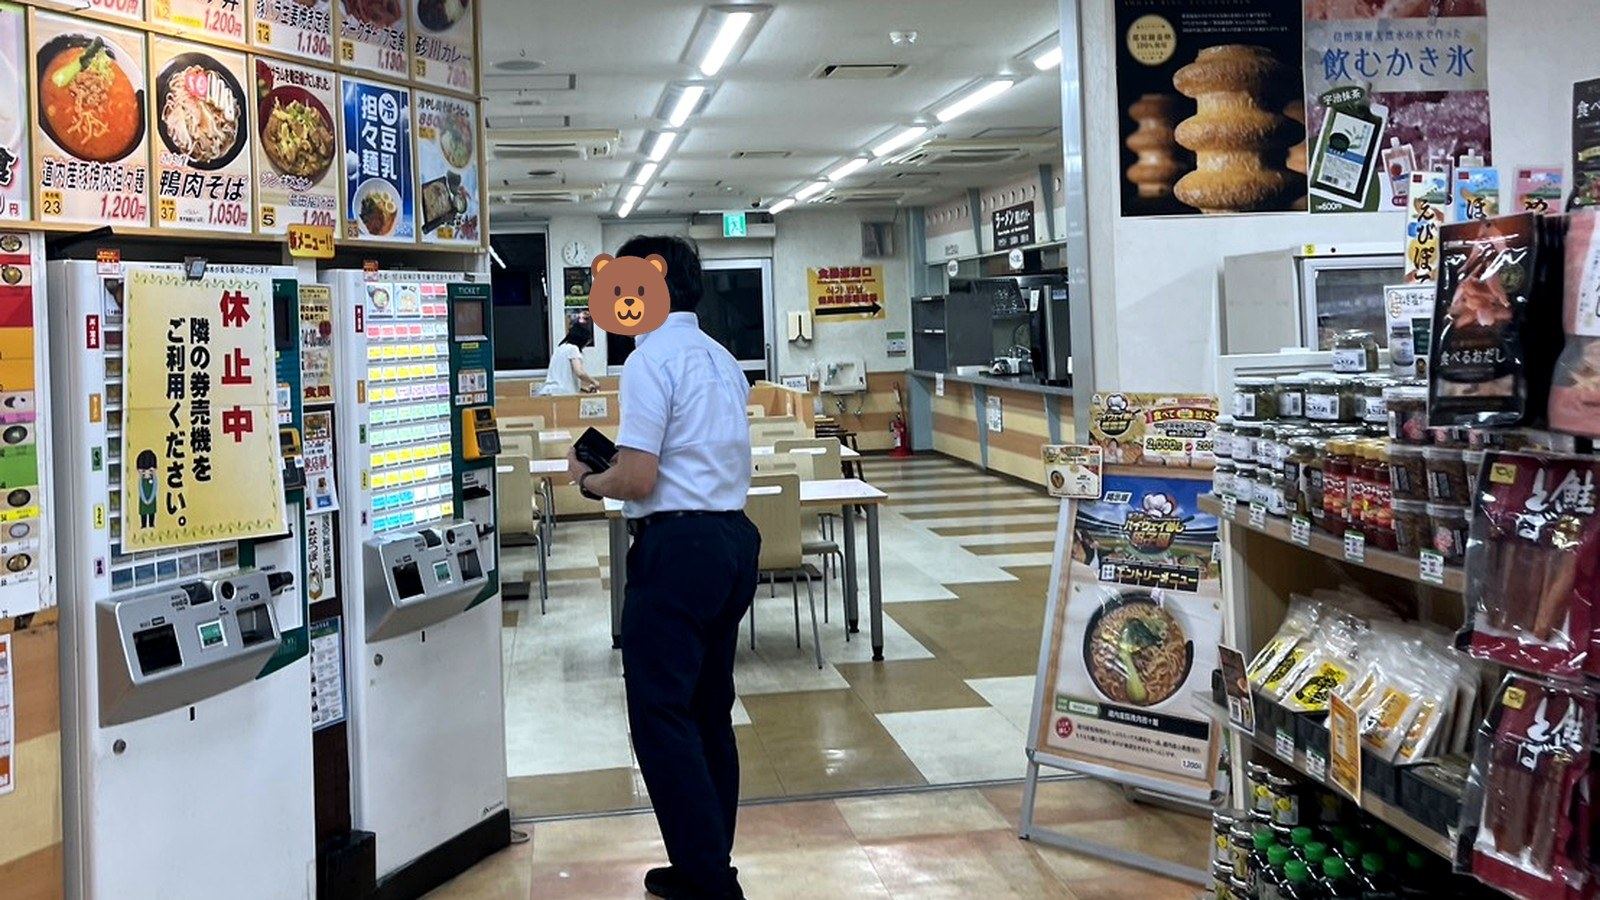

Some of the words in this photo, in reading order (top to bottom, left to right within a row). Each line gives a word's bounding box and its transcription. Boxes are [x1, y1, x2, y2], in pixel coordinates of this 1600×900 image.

[415, 35, 472, 62] 砂川カレー
[1322, 45, 1476, 81] 飲むかき氷
[1322, 89, 1361, 105] 宇治抹茶
[361, 93, 380, 177] 担々麺
[159, 169, 247, 201] 鴨肉そば
[43, 200, 61, 215] 23
[101, 195, 147, 220] 1,200円
[161, 206, 176, 220] 37
[208, 202, 248, 227] 1,050円
[262, 214, 275, 226] 5
[220, 290, 254, 443] 休止中
[1441, 348, 1506, 366] 食べるおだし
[190, 317, 212, 482] 隣の券売機を
[165, 317, 187, 527] ご利用ください。
[1117, 565, 1198, 585] エントリーメニュー
